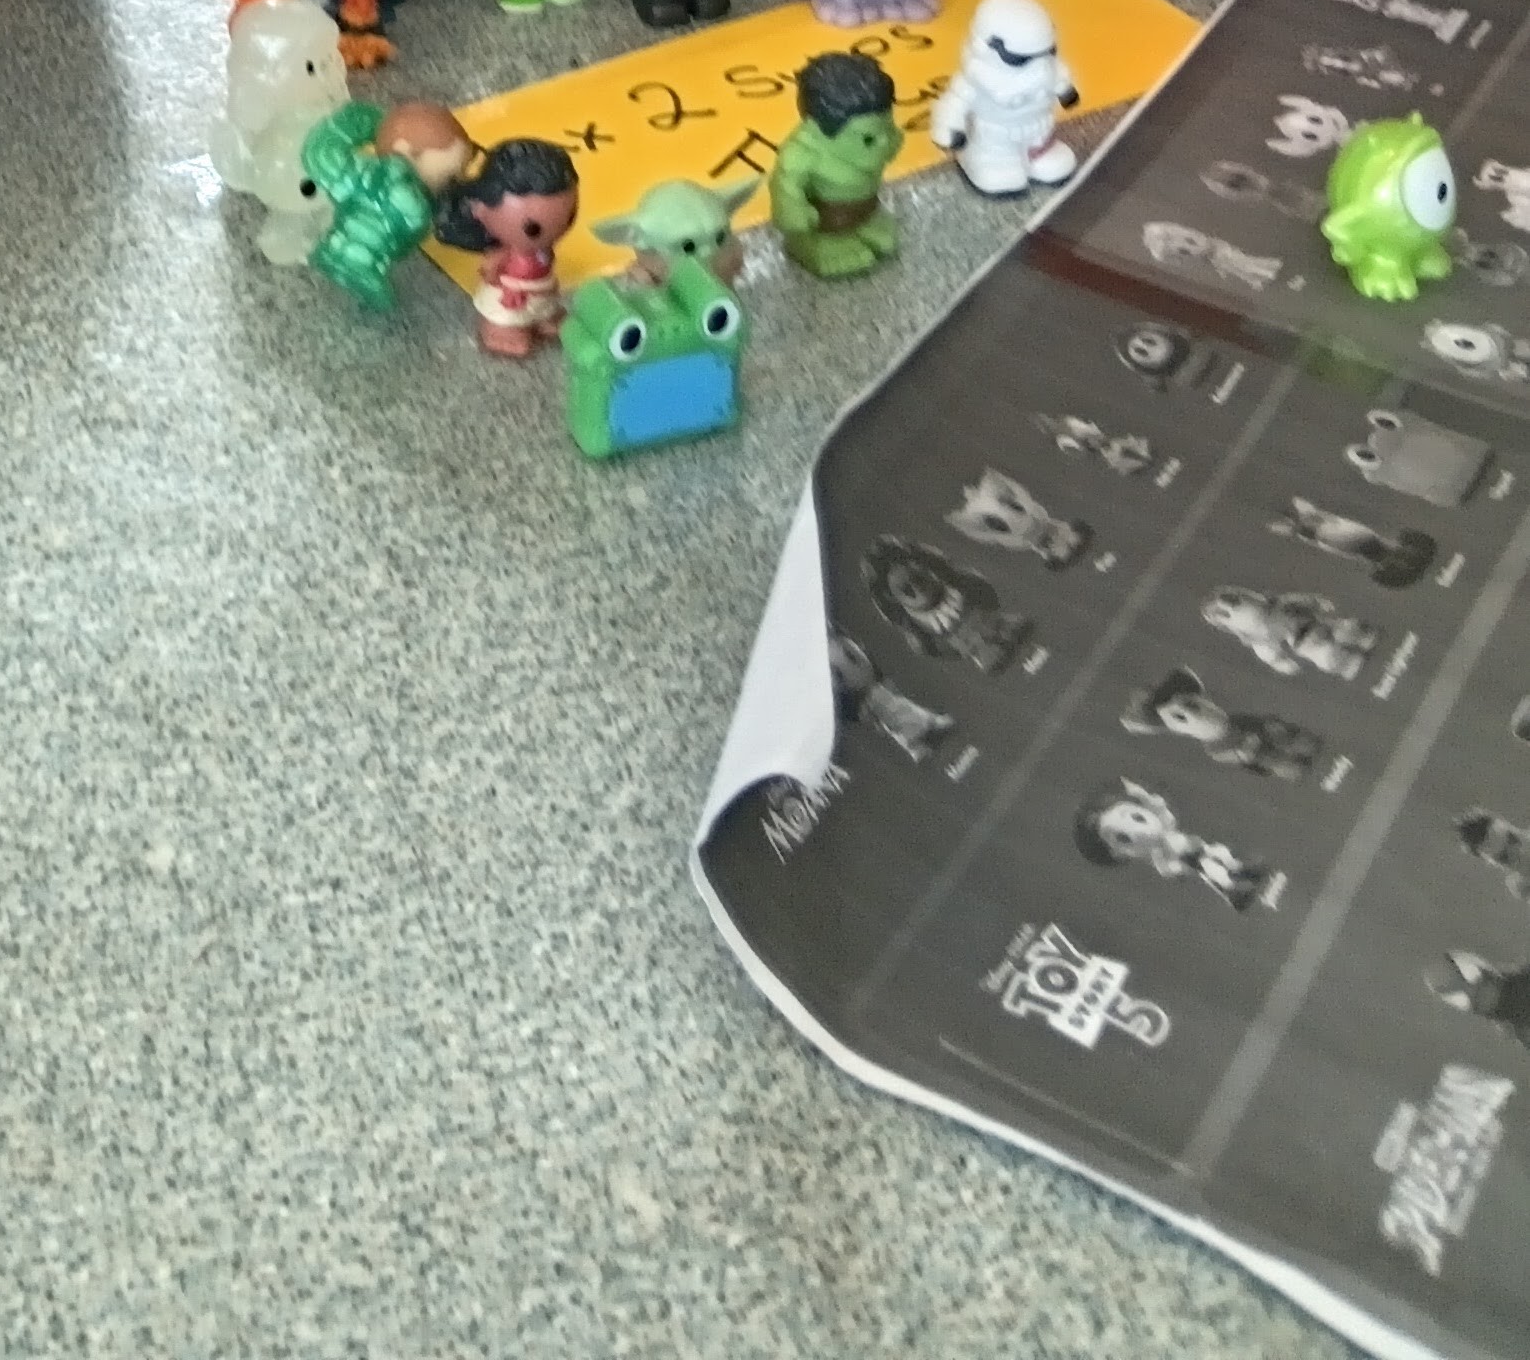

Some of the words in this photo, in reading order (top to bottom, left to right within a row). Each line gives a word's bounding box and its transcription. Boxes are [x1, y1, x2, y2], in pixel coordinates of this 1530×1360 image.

[627, 80, 718, 132] 2
[1002, 922, 1090, 1018] TOY
[1104, 992, 1170, 1047] 5
